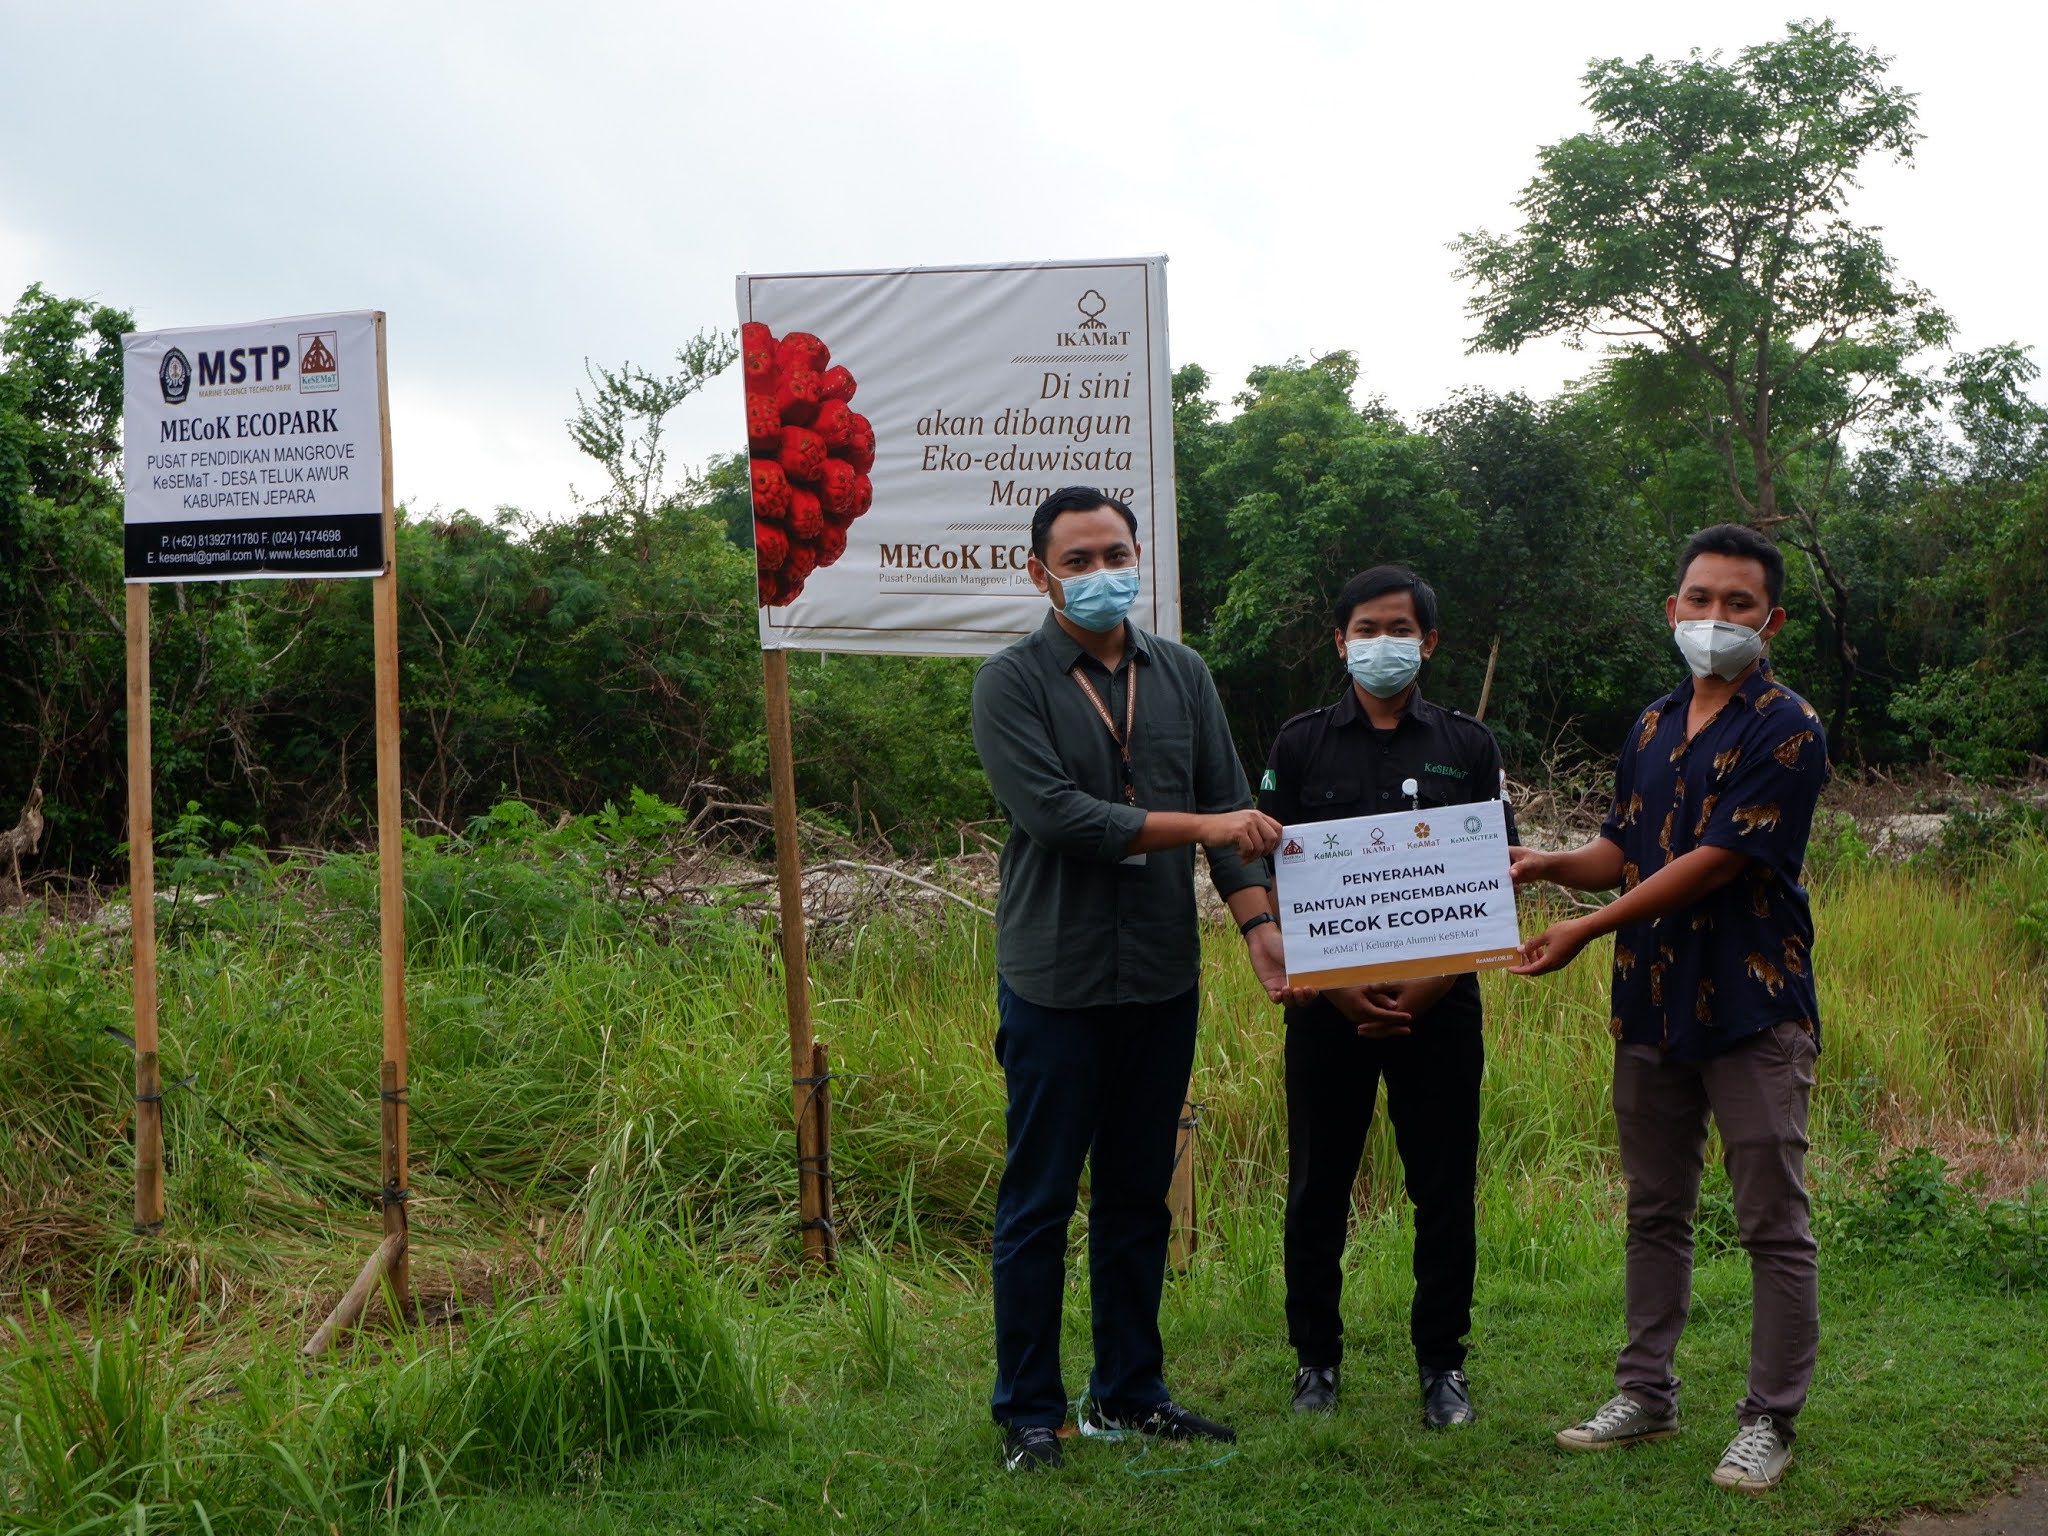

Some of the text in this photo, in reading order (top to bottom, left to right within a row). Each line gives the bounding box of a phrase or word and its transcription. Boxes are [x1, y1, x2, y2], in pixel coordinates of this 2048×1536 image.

[1056, 330, 1131, 348] IKAMaT
[198, 345, 291, 387] MSTP
[302, 374, 336, 384] KeSEMaT
[1039, 371, 1131, 400] Di sini
[198, 389, 222, 398] MARINE
[223, 387, 248, 396] SCIENCE
[249, 386, 274, 394] TECHNO
[275, 384, 292, 392] PARK
[160, 408, 338, 443] MECoK ECOPARK
[916, 407, 1132, 444] akan dibangun
[147, 444, 355, 470] PUSAT PENDIDIKAN MANGROVE
[921, 444, 1133, 472] Eko-eduwisata
[153, 474, 210, 490] KeSEMaT
[222, 470, 258, 486] DESA
[260, 468, 306, 485] TELUK
[306, 465, 350, 482] AWUR
[183, 488, 316, 509] KABUPATEN JEPARA
[988, 480, 1135, 507] Manve
[162, 530, 342, 549] P. (+62) 81392711780 F. (024) 7474698
[147, 545, 358, 565] E. kesemat@gmail.com W. www.kesemat.or.id
[879, 543, 1035, 570] MECoK EC
[879, 573, 904, 584] Pusat
[906, 574, 958, 584] Pendidikan
[960, 574, 1007, 587] Mangrove
[1015, 575, 1036, 585] Des
[1424, 762, 1468, 780] KeSEMaT
[1362, 844, 1396, 855] IKAMaT
[1406, 838, 1441, 850] KeAMaT
[1450, 832, 1498, 844] KeMANGTEER
[1314, 850, 1352, 861] KeMANGI
[1342, 863, 1445, 886] PENYERAHAN
[1293, 878, 1500, 914] BANTUAN PENGEMBANGAN
[1308, 902, 1488, 938] MECoK ECOPARK
[1323, 942, 1359, 956] KeAMaT
[1366, 936, 1404, 951] Keluarga
[1406, 932, 1437, 946] Alumni
[1438, 928, 1480, 942] KeSEMaT
